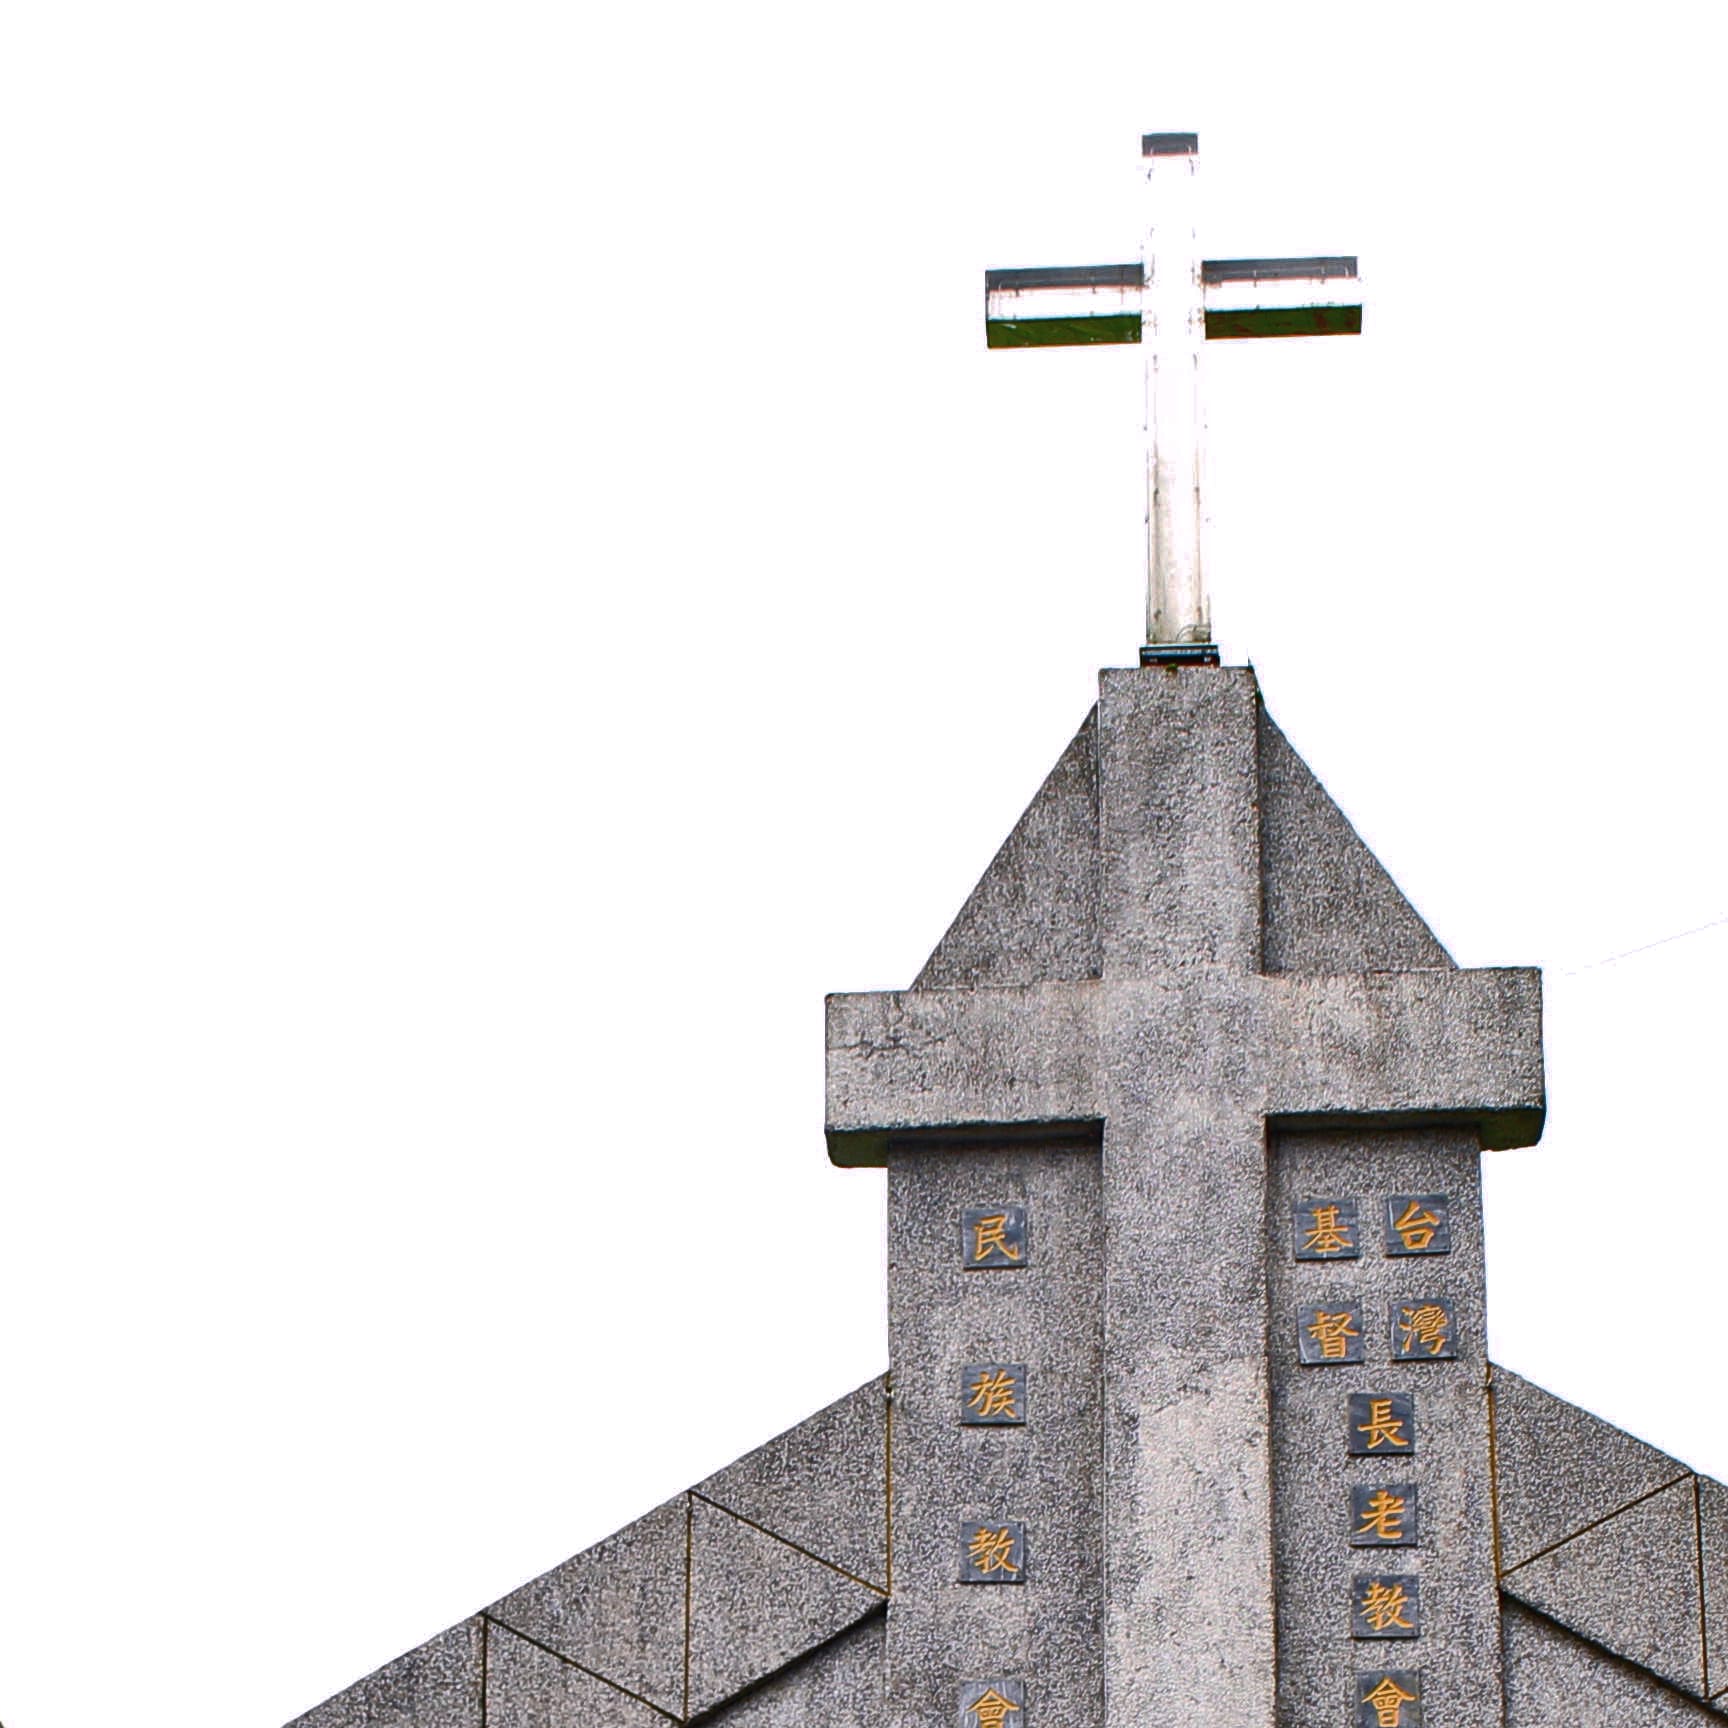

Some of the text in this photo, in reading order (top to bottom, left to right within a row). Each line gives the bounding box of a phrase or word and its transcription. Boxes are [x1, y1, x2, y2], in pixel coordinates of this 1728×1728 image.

[1302, 1203, 1359, 1358] 基督
[1394, 1199, 1449, 1355] 台灣
[1358, 1398, 1417, 1728] 長老教會
